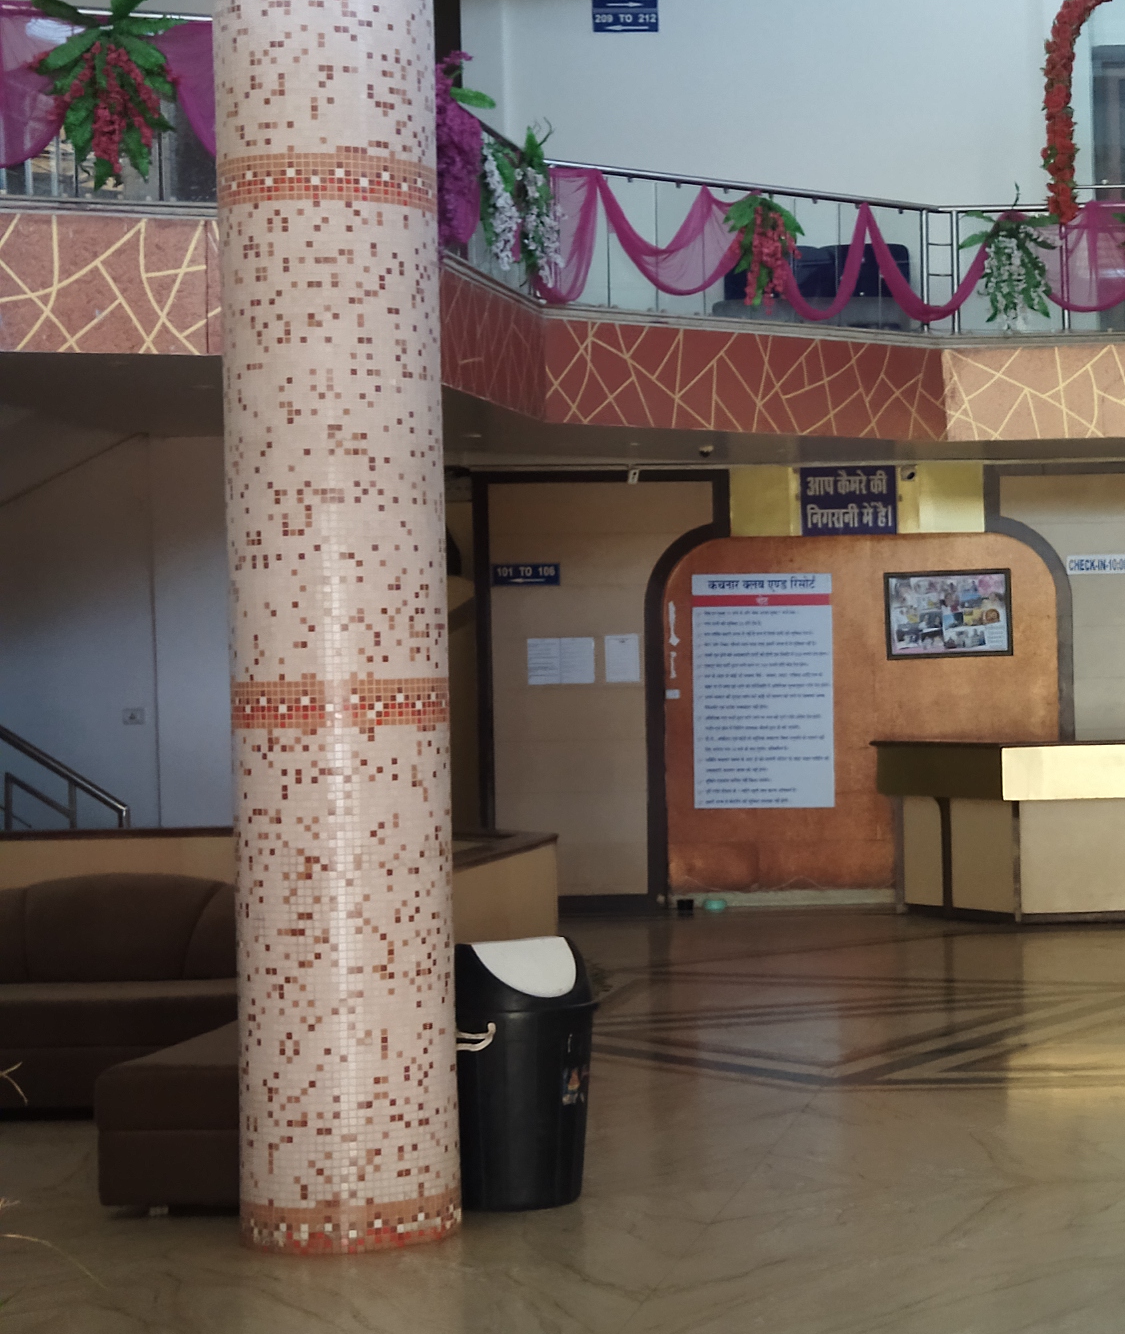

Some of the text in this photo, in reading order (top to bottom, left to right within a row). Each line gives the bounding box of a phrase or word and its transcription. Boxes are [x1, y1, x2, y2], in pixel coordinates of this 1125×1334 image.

[619, 14, 633, 23] TO
[638, 14, 656, 23] 212
[806, 470, 887, 496] आप कैमरे की
[807, 504, 858, 529] निगरानी
[497, 567, 513, 576] 101
[519, 567, 532, 576] TO
[708, 580, 739, 590] कचनार
